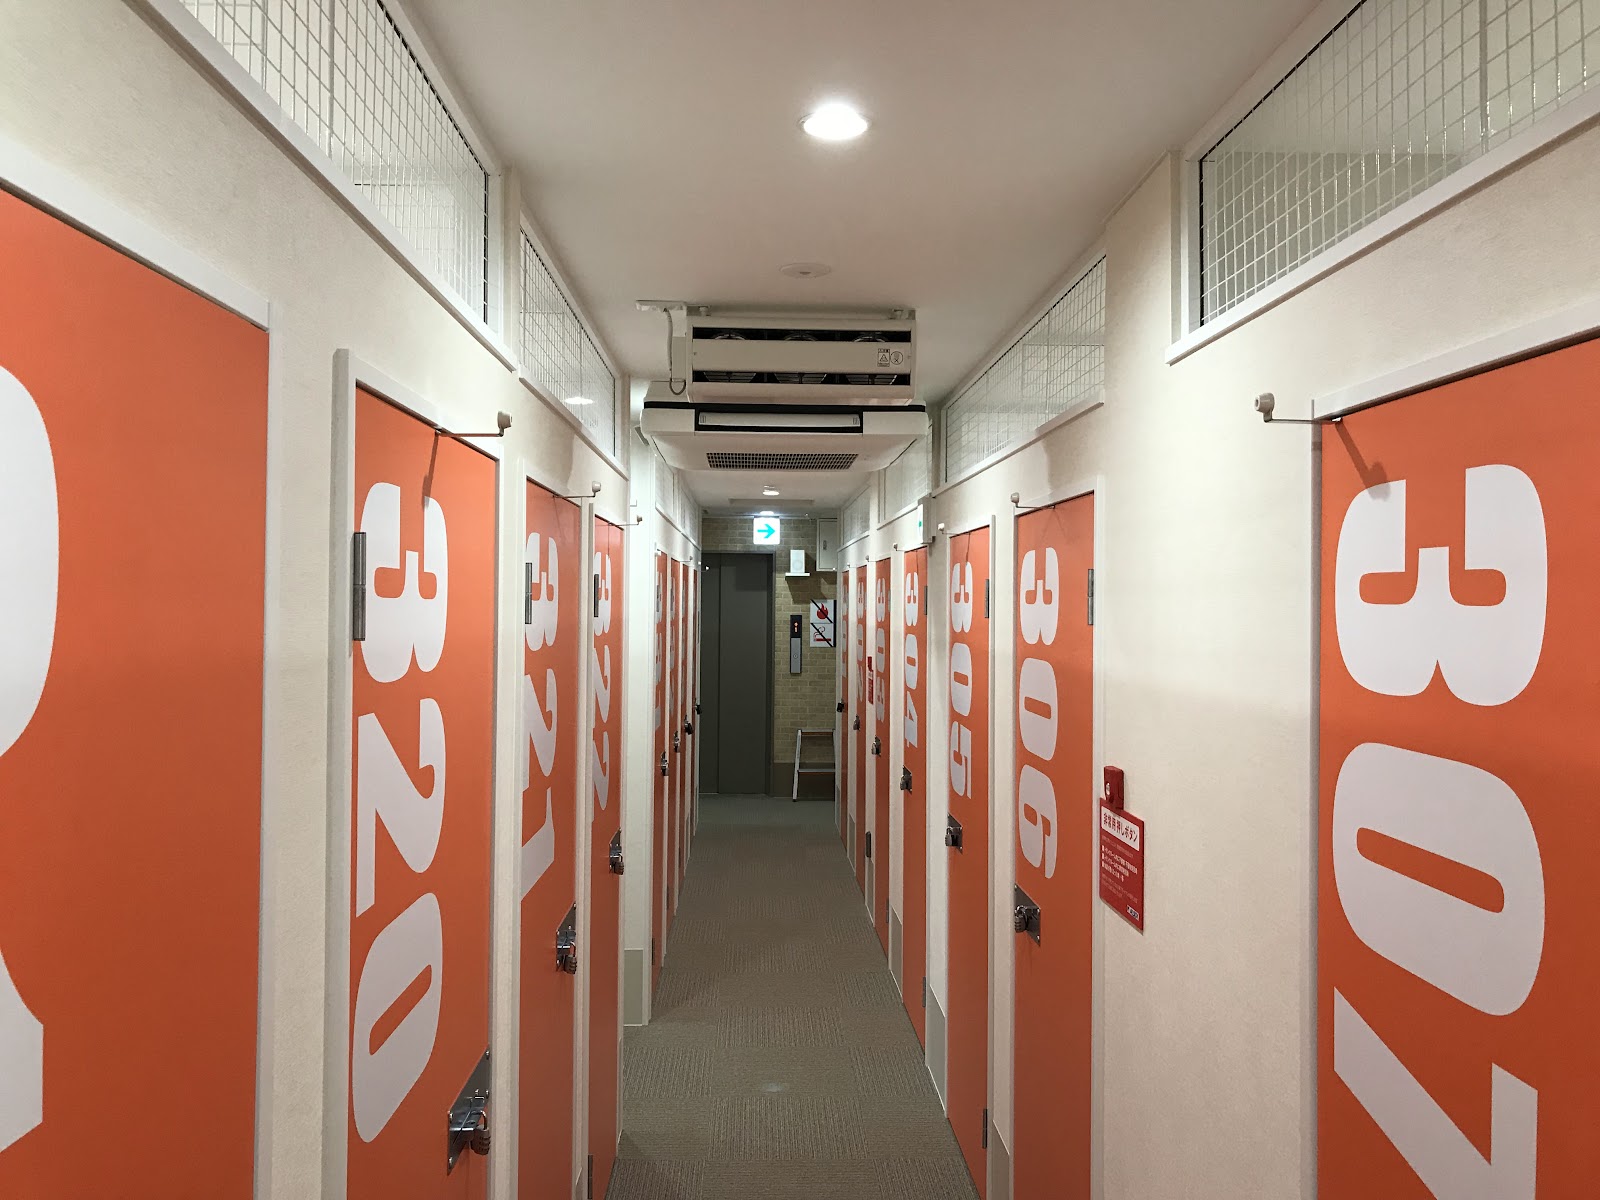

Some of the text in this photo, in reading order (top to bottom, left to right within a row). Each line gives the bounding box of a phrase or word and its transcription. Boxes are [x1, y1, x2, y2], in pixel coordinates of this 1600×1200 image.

[521, 532, 559, 899] 321
[591, 552, 611, 821] 322
[876, 577, 886, 723] 303
[904, 571, 919, 749] 304
[950, 560, 973, 800] 305
[1018, 547, 1060, 879] 306
[352, 481, 448, 1143] 320
[1332, 464, 1548, 1200] 307
